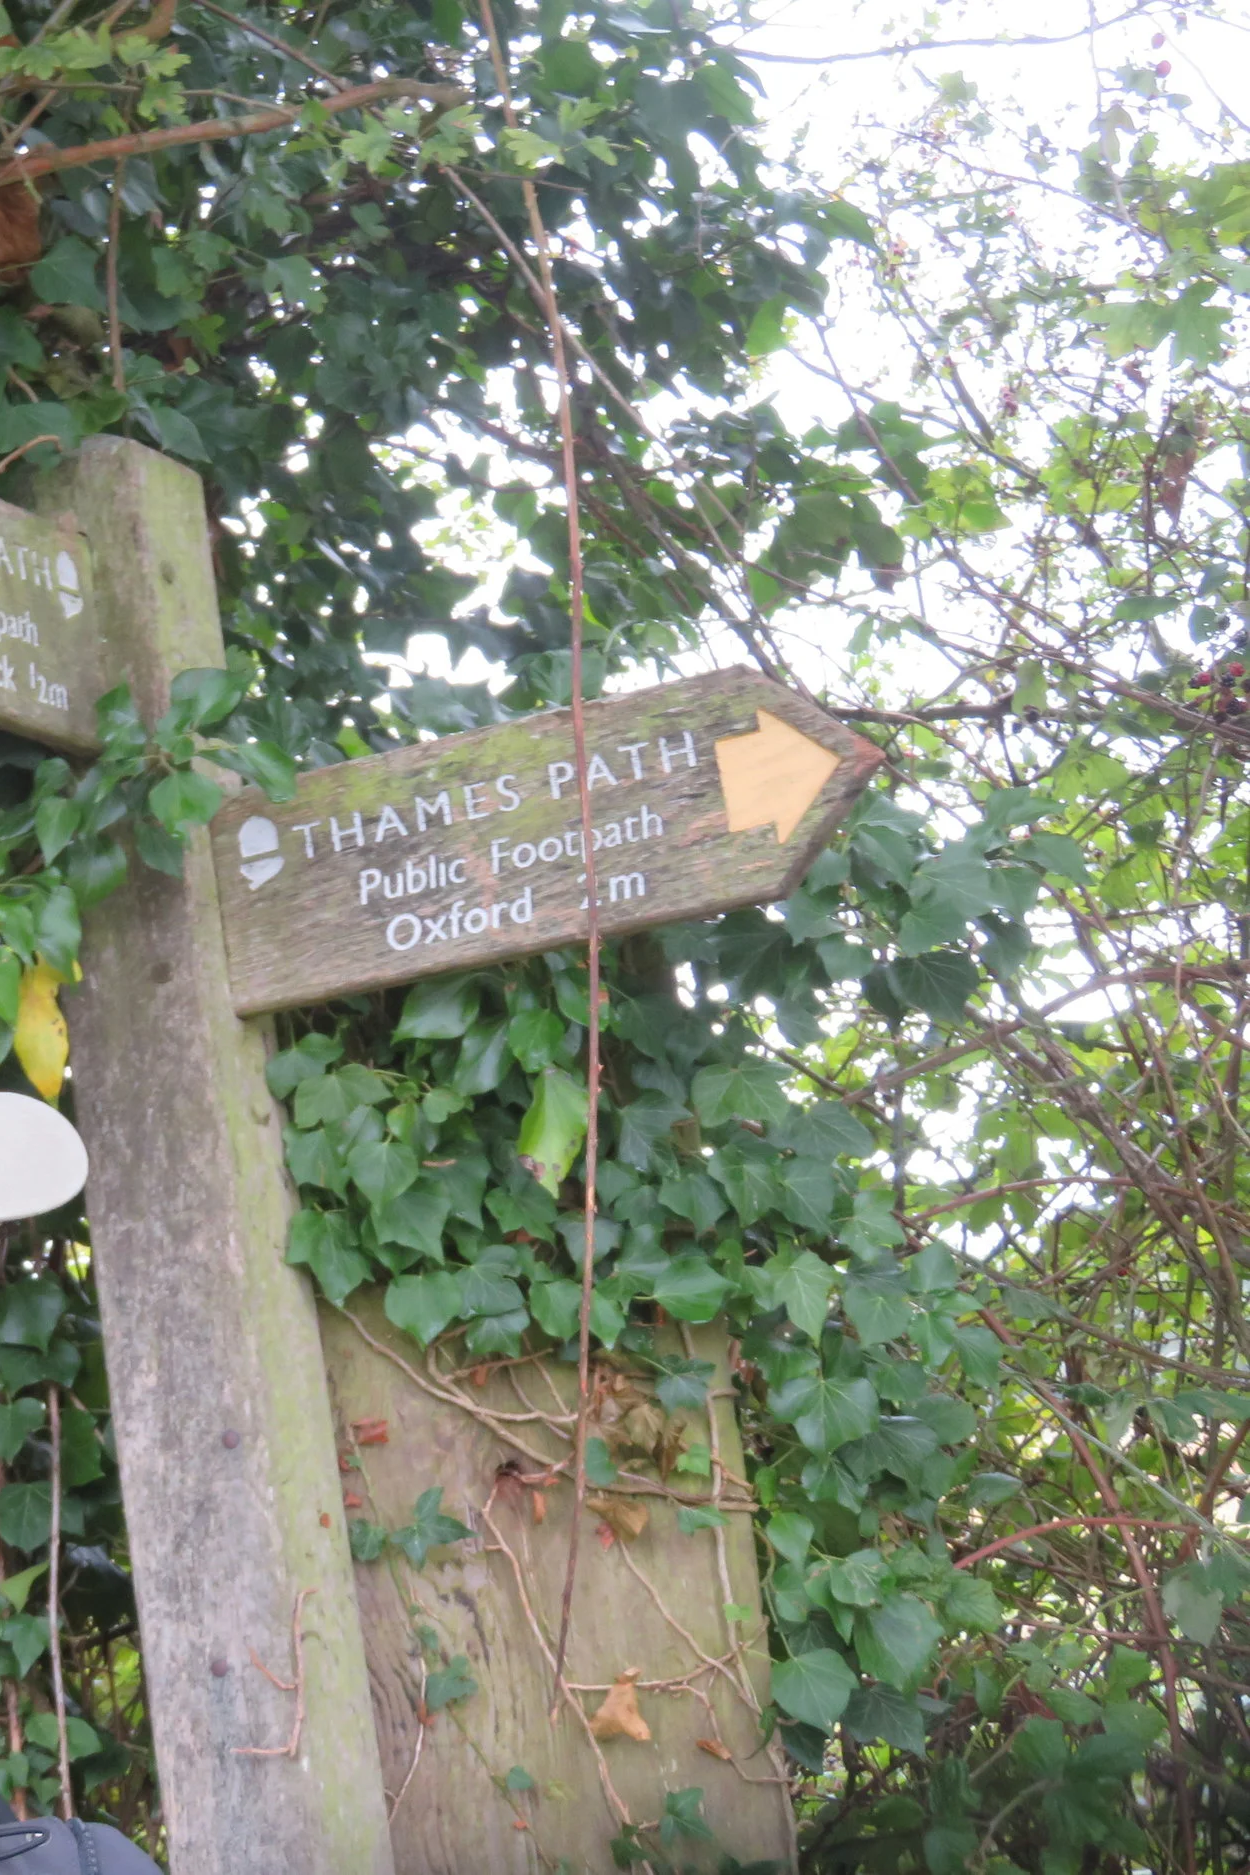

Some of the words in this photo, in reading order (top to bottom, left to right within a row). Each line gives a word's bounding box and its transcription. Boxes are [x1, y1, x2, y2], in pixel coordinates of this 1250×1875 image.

[291, 774, 522, 859] THAMES
[547, 728, 699, 801] PATH
[358, 854, 469, 906] Public
[489, 804, 665, 875] Footpath
[385, 886, 534, 951] Oxford
